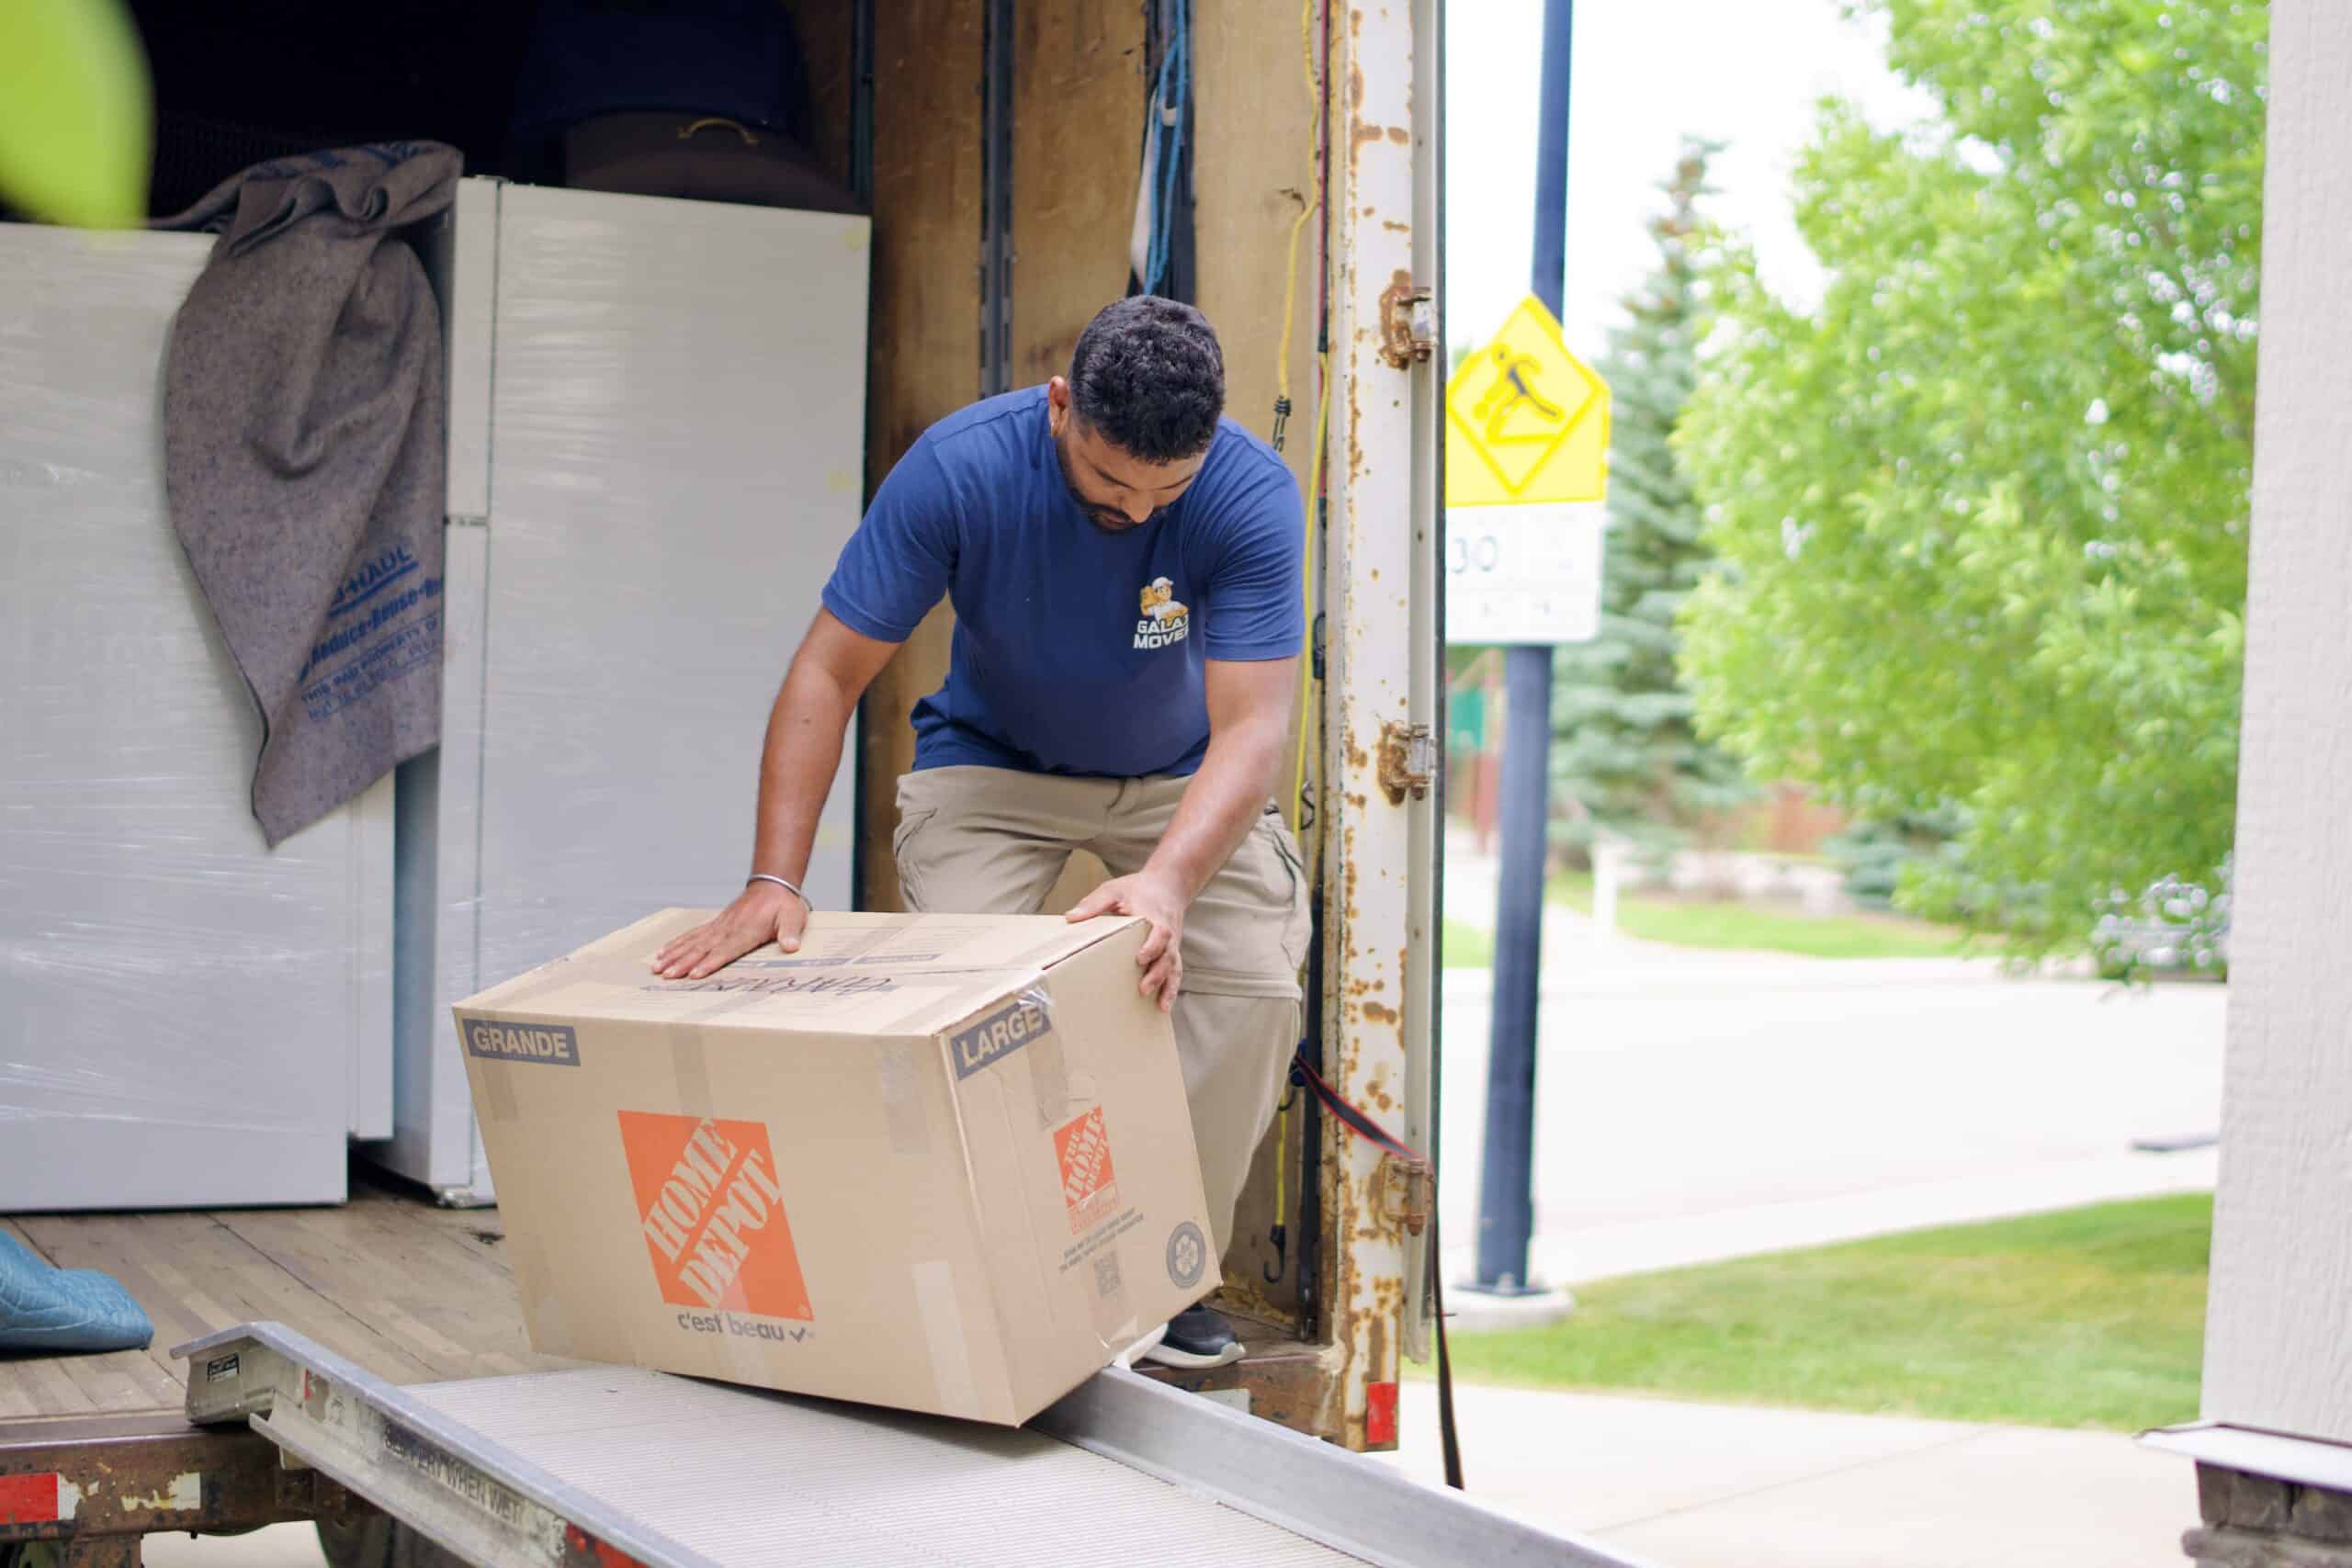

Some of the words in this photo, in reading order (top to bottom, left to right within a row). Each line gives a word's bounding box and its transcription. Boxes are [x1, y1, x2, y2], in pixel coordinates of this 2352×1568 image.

[471, 1026, 570, 1058] GRANDE
[960, 1006, 1044, 1068] LARGE
[644, 1116, 739, 1264] HOME
[679, 1148, 781, 1310] DEPOT
[678, 1313, 724, 1335] c'est
[727, 1314, 786, 1342] beau
[447, 1458, 486, 1506] WHEN
